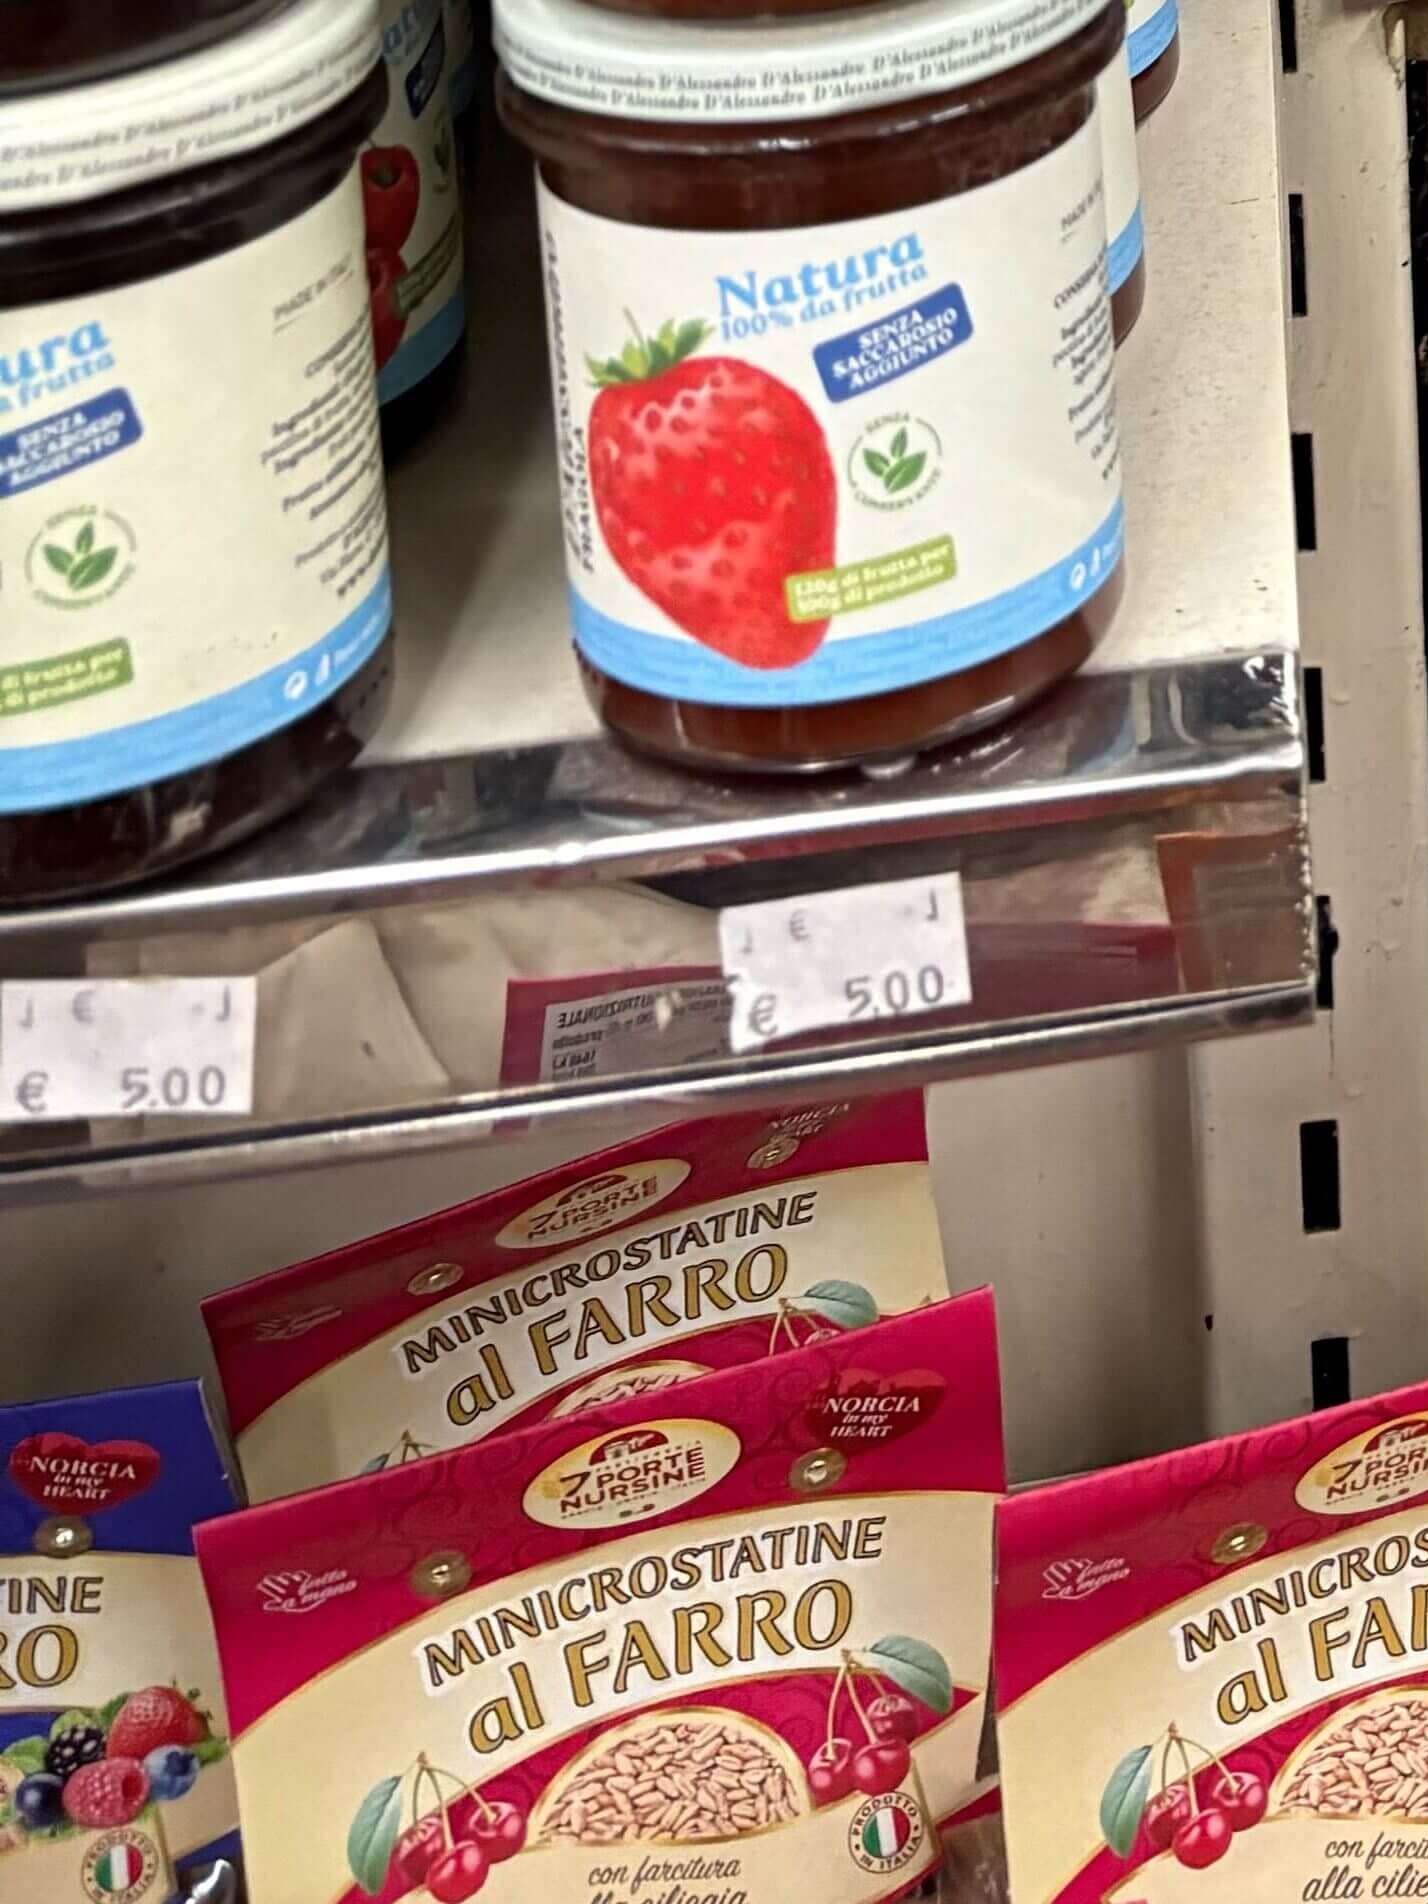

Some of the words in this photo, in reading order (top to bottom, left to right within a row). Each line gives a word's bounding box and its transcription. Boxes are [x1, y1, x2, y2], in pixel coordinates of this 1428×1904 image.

[714, 231, 925, 316] Natura
[830, 307, 959, 379] SACCAROSIO
[858, 309, 923, 352] SENZA
[849, 328, 954, 391] AGGIUNTO
[401, 1192, 818, 1375] MINICROSTATINE
[447, 1342, 505, 1425] al
[526, 1242, 787, 1375] FARRO
[822, 1395, 920, 1413] NORCIA
[829, 1425, 893, 1438] HEART
[28, 1455, 137, 1480] NORCIA
[42, 1484, 110, 1500] HEART
[422, 1516, 886, 1688] MINICROSTATINE
[469, 1686, 540, 1756] al
[561, 1578, 853, 1709] FARRO
[1217, 1642, 1287, 1724] al
[588, 1859, 631, 1885] con
[637, 1853, 741, 1891] farcitura
[1324, 1839, 1366, 1860] con
[1302, 1871, 1366, 1901] alla
